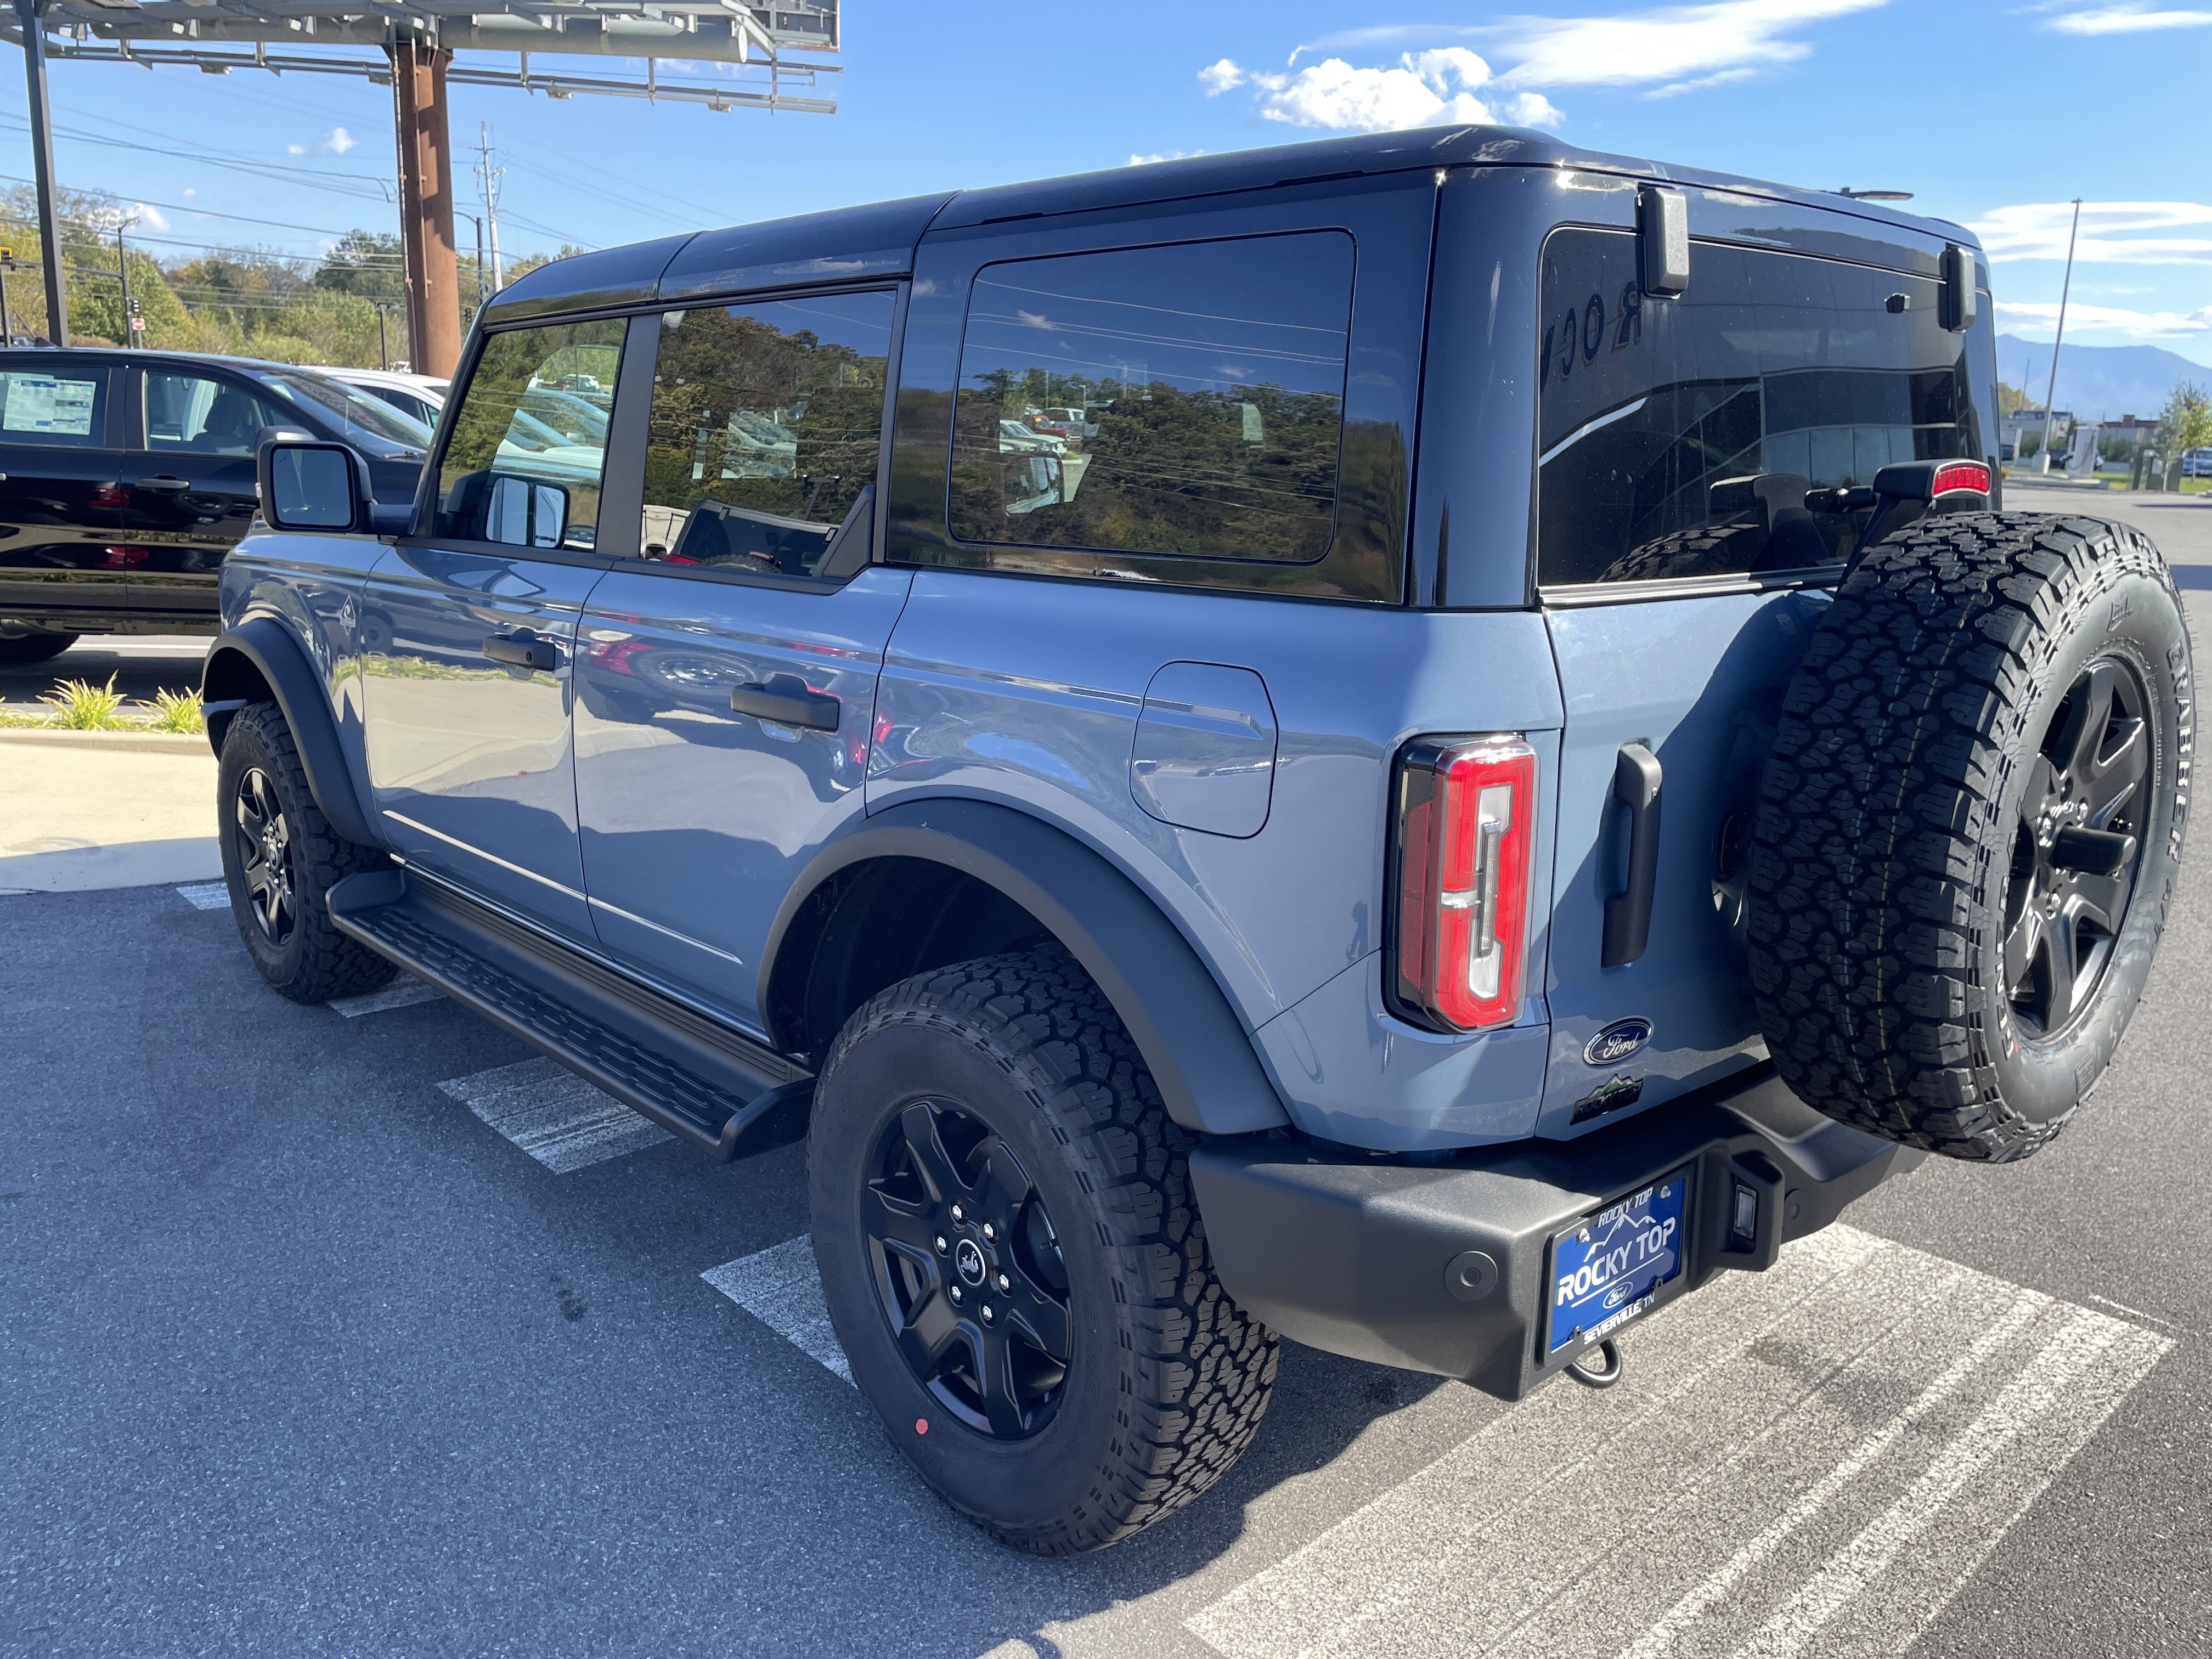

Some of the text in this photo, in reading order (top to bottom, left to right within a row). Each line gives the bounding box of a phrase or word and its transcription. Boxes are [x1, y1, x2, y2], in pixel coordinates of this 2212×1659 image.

[2166, 638, 2192, 861] GRABBER
[1602, 1032, 1640, 1059] Ford
[1576, 1085, 1641, 1116] ROCKY TOP
[1598, 1187, 1653, 1228] ROCKY TOP
[1557, 1217, 1675, 1306] ROCKY TOP
[1608, 1286, 1628, 1305] Ford
[1584, 1292, 1655, 1345] SEVIERVILLE, TN
